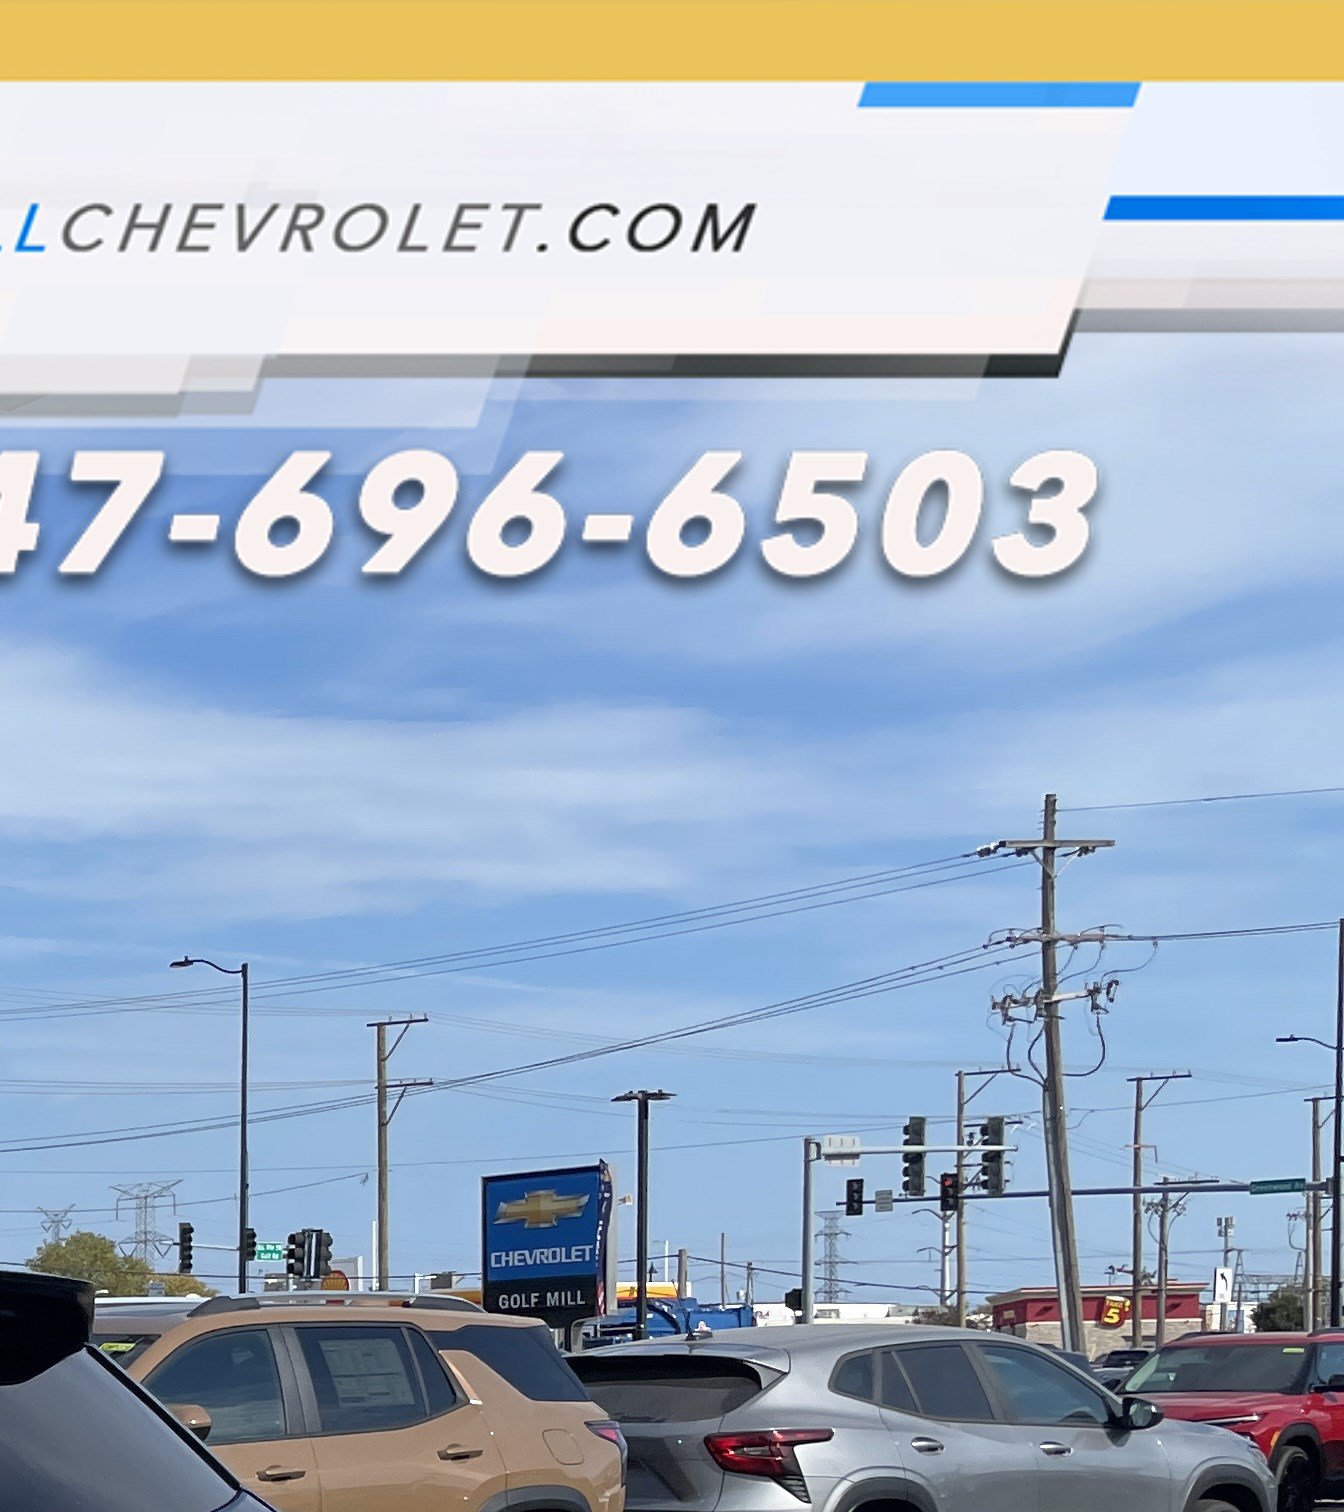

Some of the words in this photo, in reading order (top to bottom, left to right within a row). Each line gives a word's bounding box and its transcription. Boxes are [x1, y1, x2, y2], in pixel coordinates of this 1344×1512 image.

[490, 1245, 593, 1268] CHEVROLET
[498, 1292, 540, 1310] GOLF
[546, 1289, 586, 1307] MILL
[1103, 1308, 1120, 1324] 5
